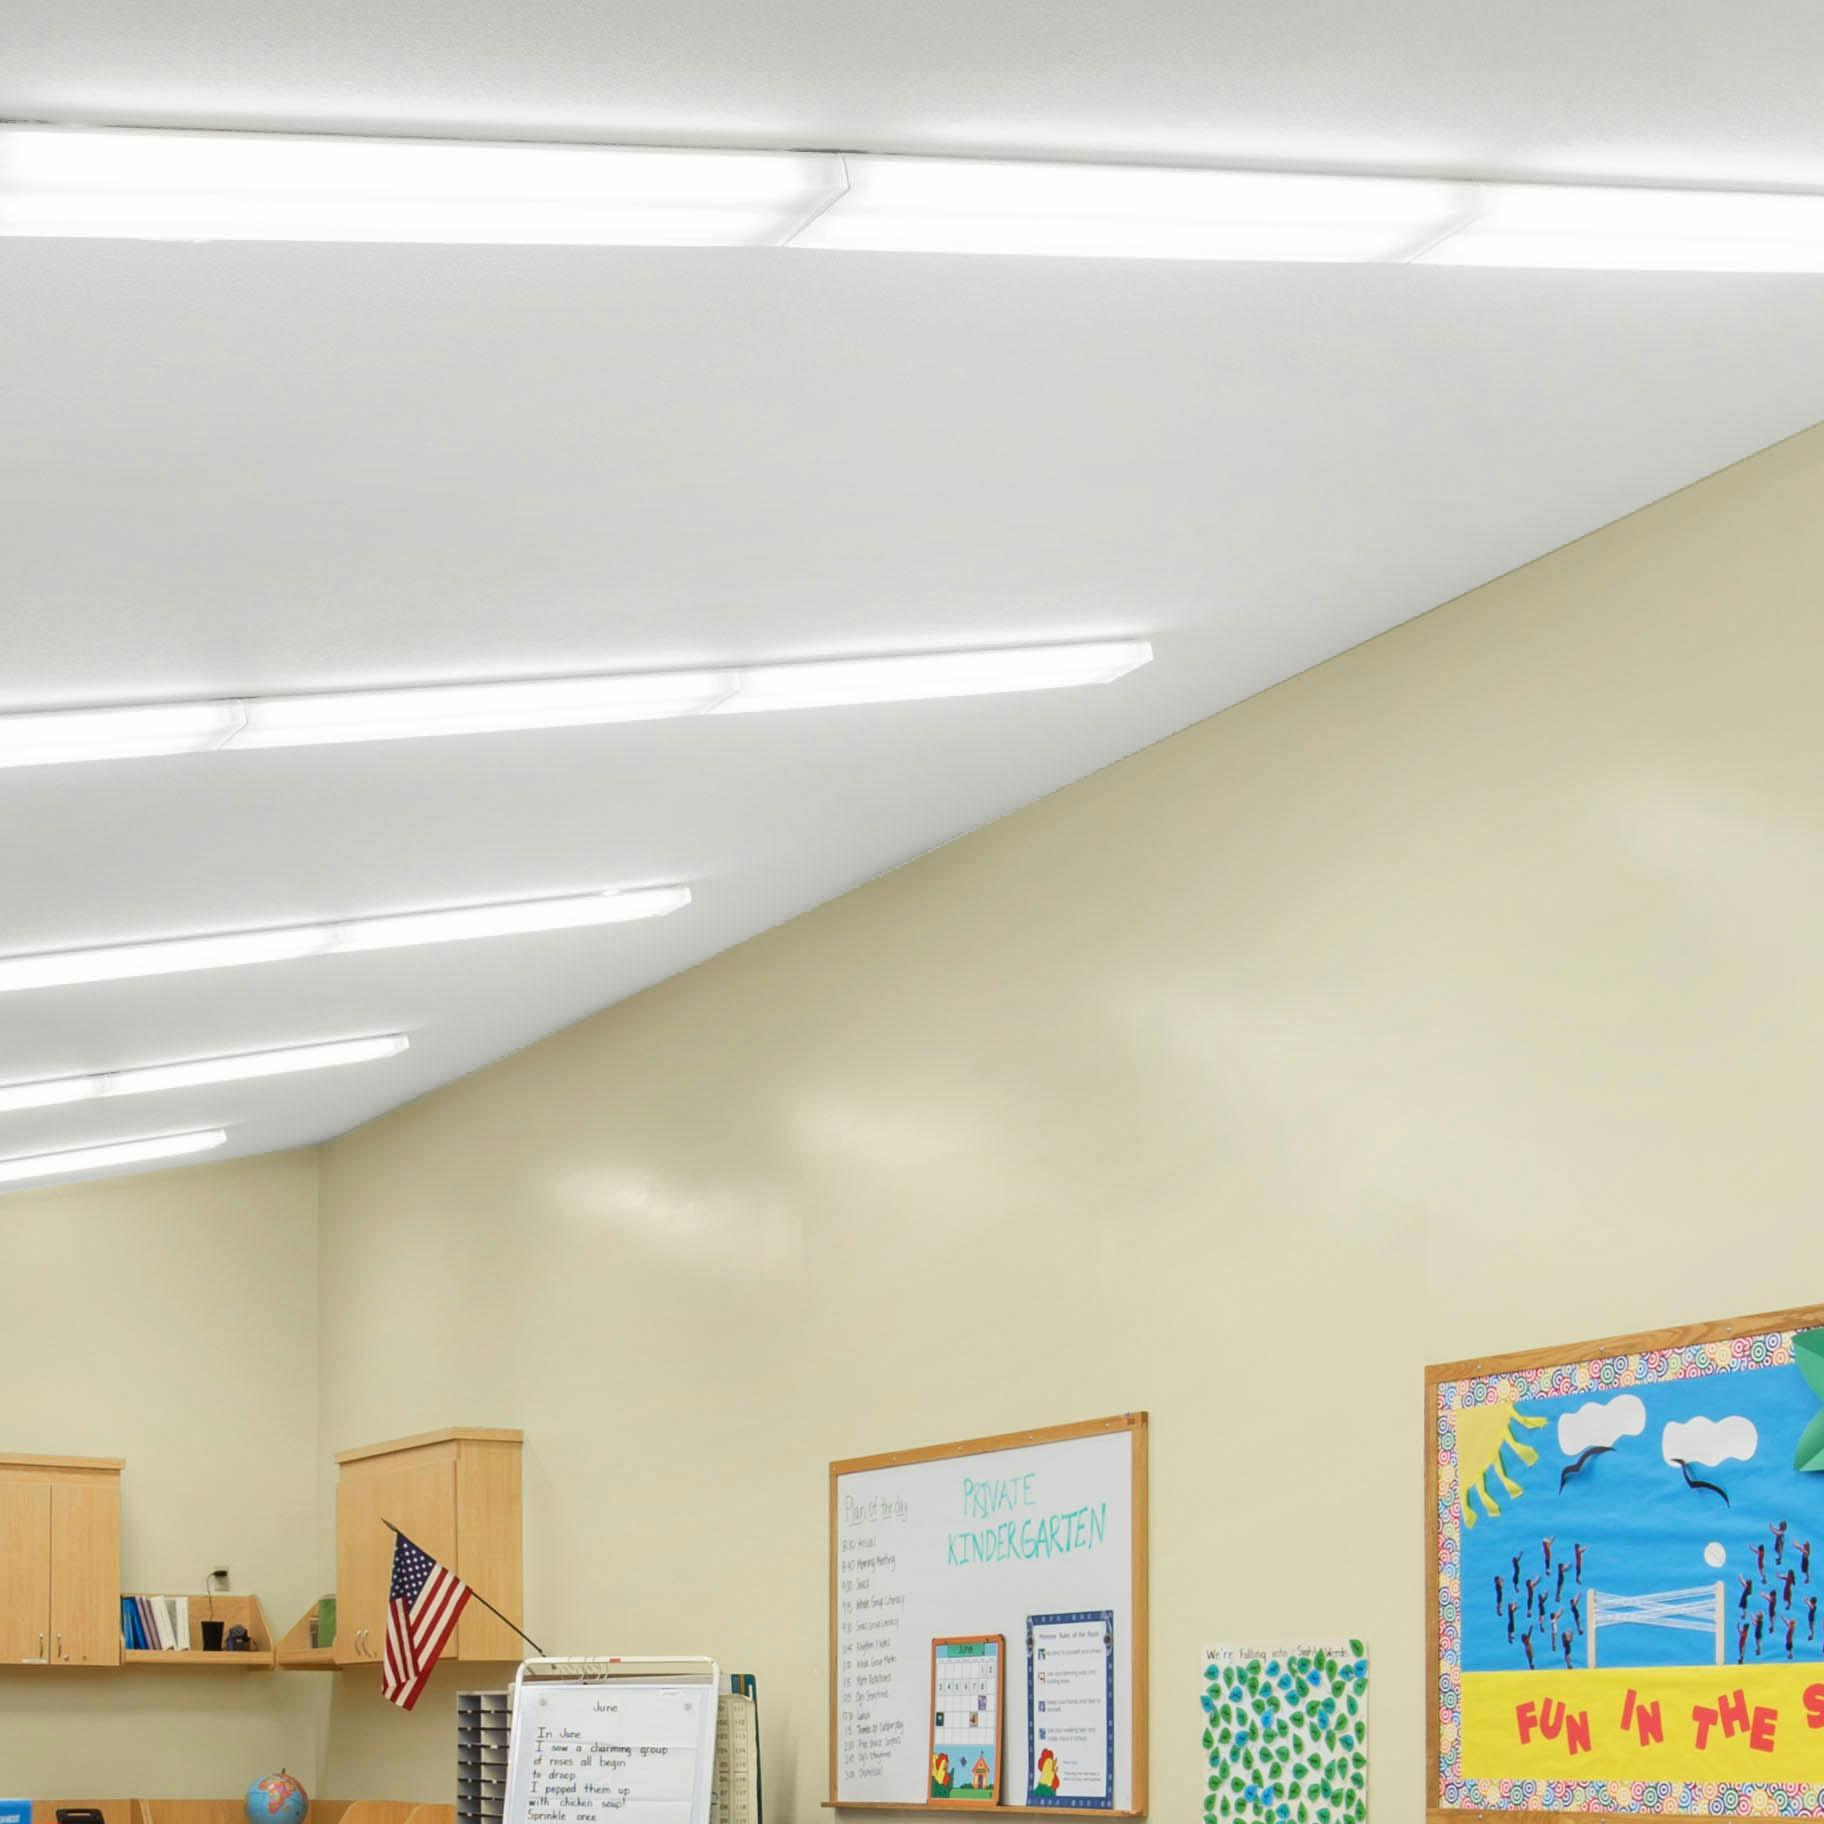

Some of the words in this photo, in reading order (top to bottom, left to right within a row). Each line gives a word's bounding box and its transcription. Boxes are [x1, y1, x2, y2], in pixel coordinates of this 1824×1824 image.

[962, 1472, 1037, 1520] PRIVATE
[947, 1502, 1107, 1567] KINDERGARTEN
[592, 1700, 619, 1713] June
[1515, 1696, 1592, 1756] FUN
[1620, 1688, 1665, 1747] IN
[1691, 1688, 1779, 1753] THE
[537, 1727, 553, 1739] In
[559, 1727, 583, 1739] June
[535, 1740, 545, 1753] I
[575, 1745, 583, 1753] a
[590, 1742, 632, 1758] charming
[639, 1745, 669, 1758] group
[549, 1758, 574, 1767] roses
[580, 1755, 593, 1767] all
[599, 1755, 627, 1770] begin
[532, 1769, 542, 1780] to
[548, 1769, 577, 1782] droop
[530, 1781, 538, 1793] I
[545, 1784, 577, 1797] pepped
[584, 1783, 612, 1794] them
[617, 1787, 631, 1797] up
[528, 1796, 550, 1807] with
[559, 1796, 594, 1808] chicken
[527, 1809, 567, 1822] Sprinkle
[576, 1813, 598, 1822] once
